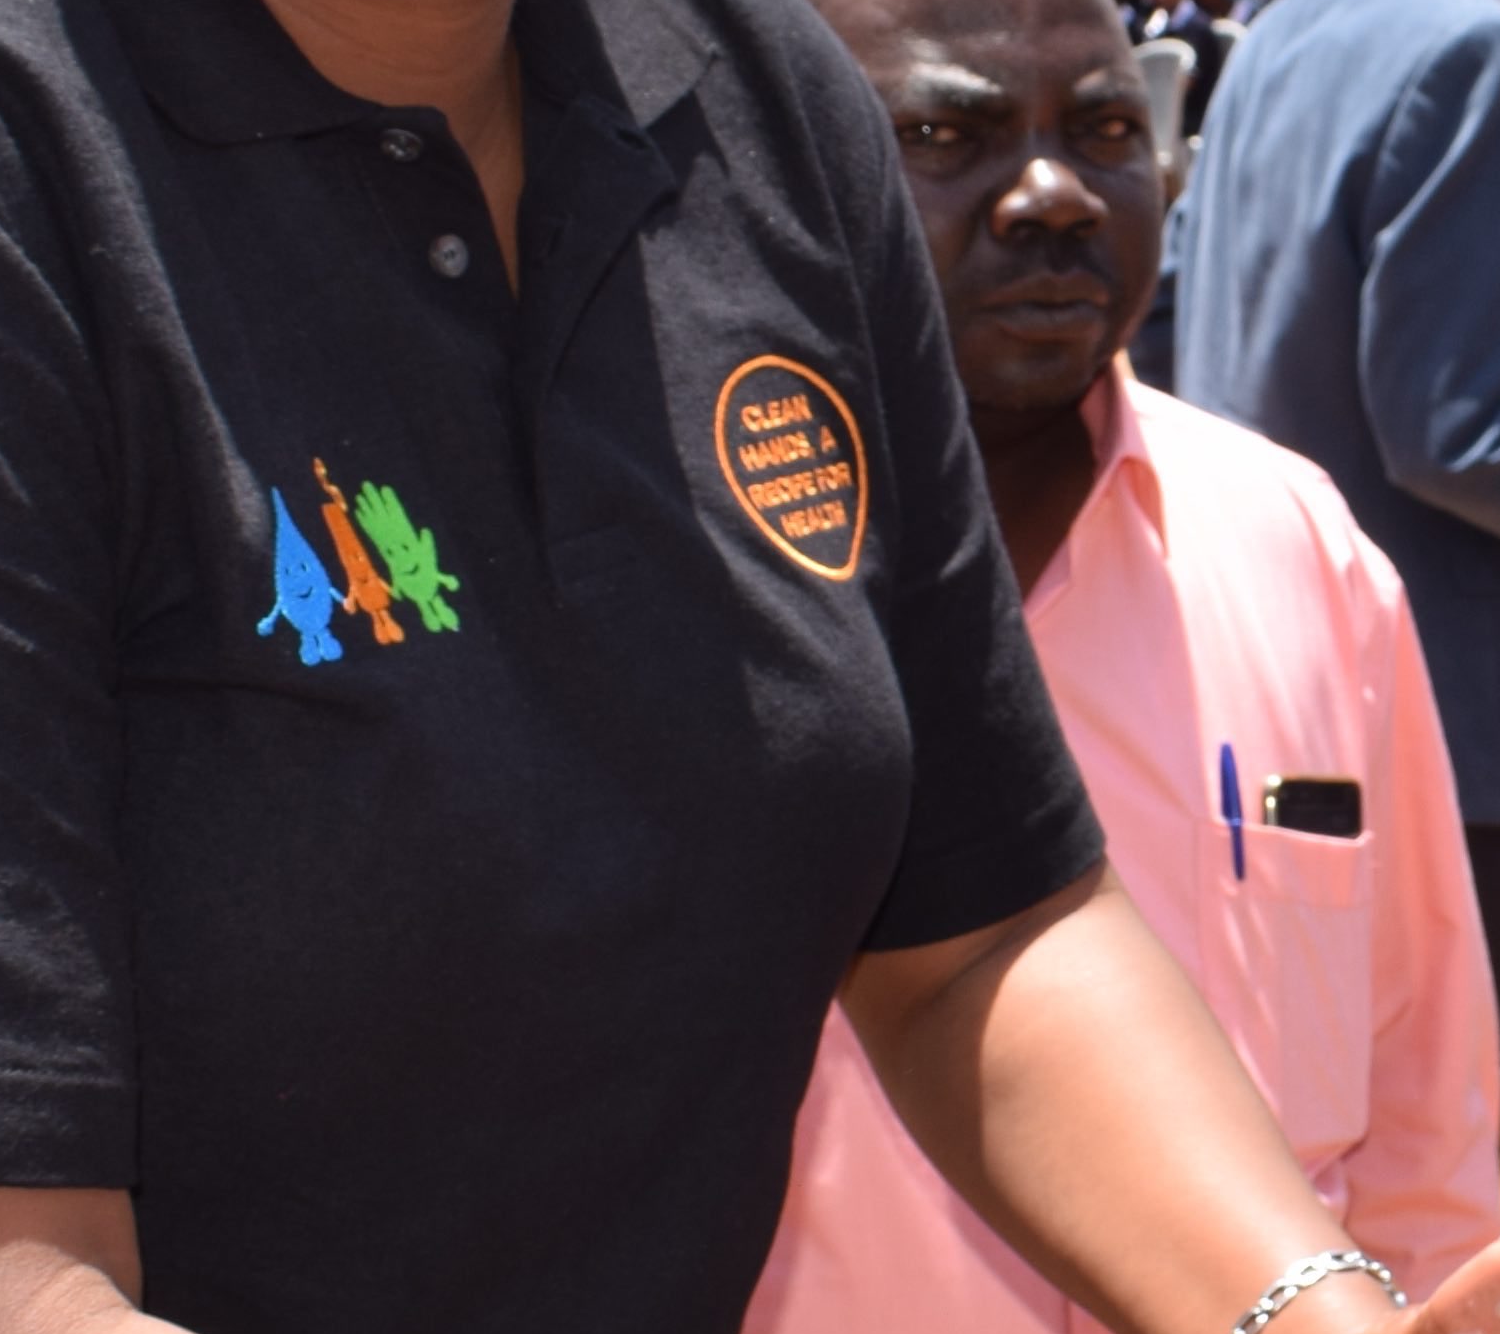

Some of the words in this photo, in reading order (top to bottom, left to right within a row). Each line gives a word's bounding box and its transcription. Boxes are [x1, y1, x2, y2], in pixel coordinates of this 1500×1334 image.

[741, 393, 812, 432] CLEAN
[820, 424, 837, 454] A
[747, 471, 817, 509] RECIPE
[813, 461, 851, 493] FOR
[780, 499, 847, 537] HEALTH
